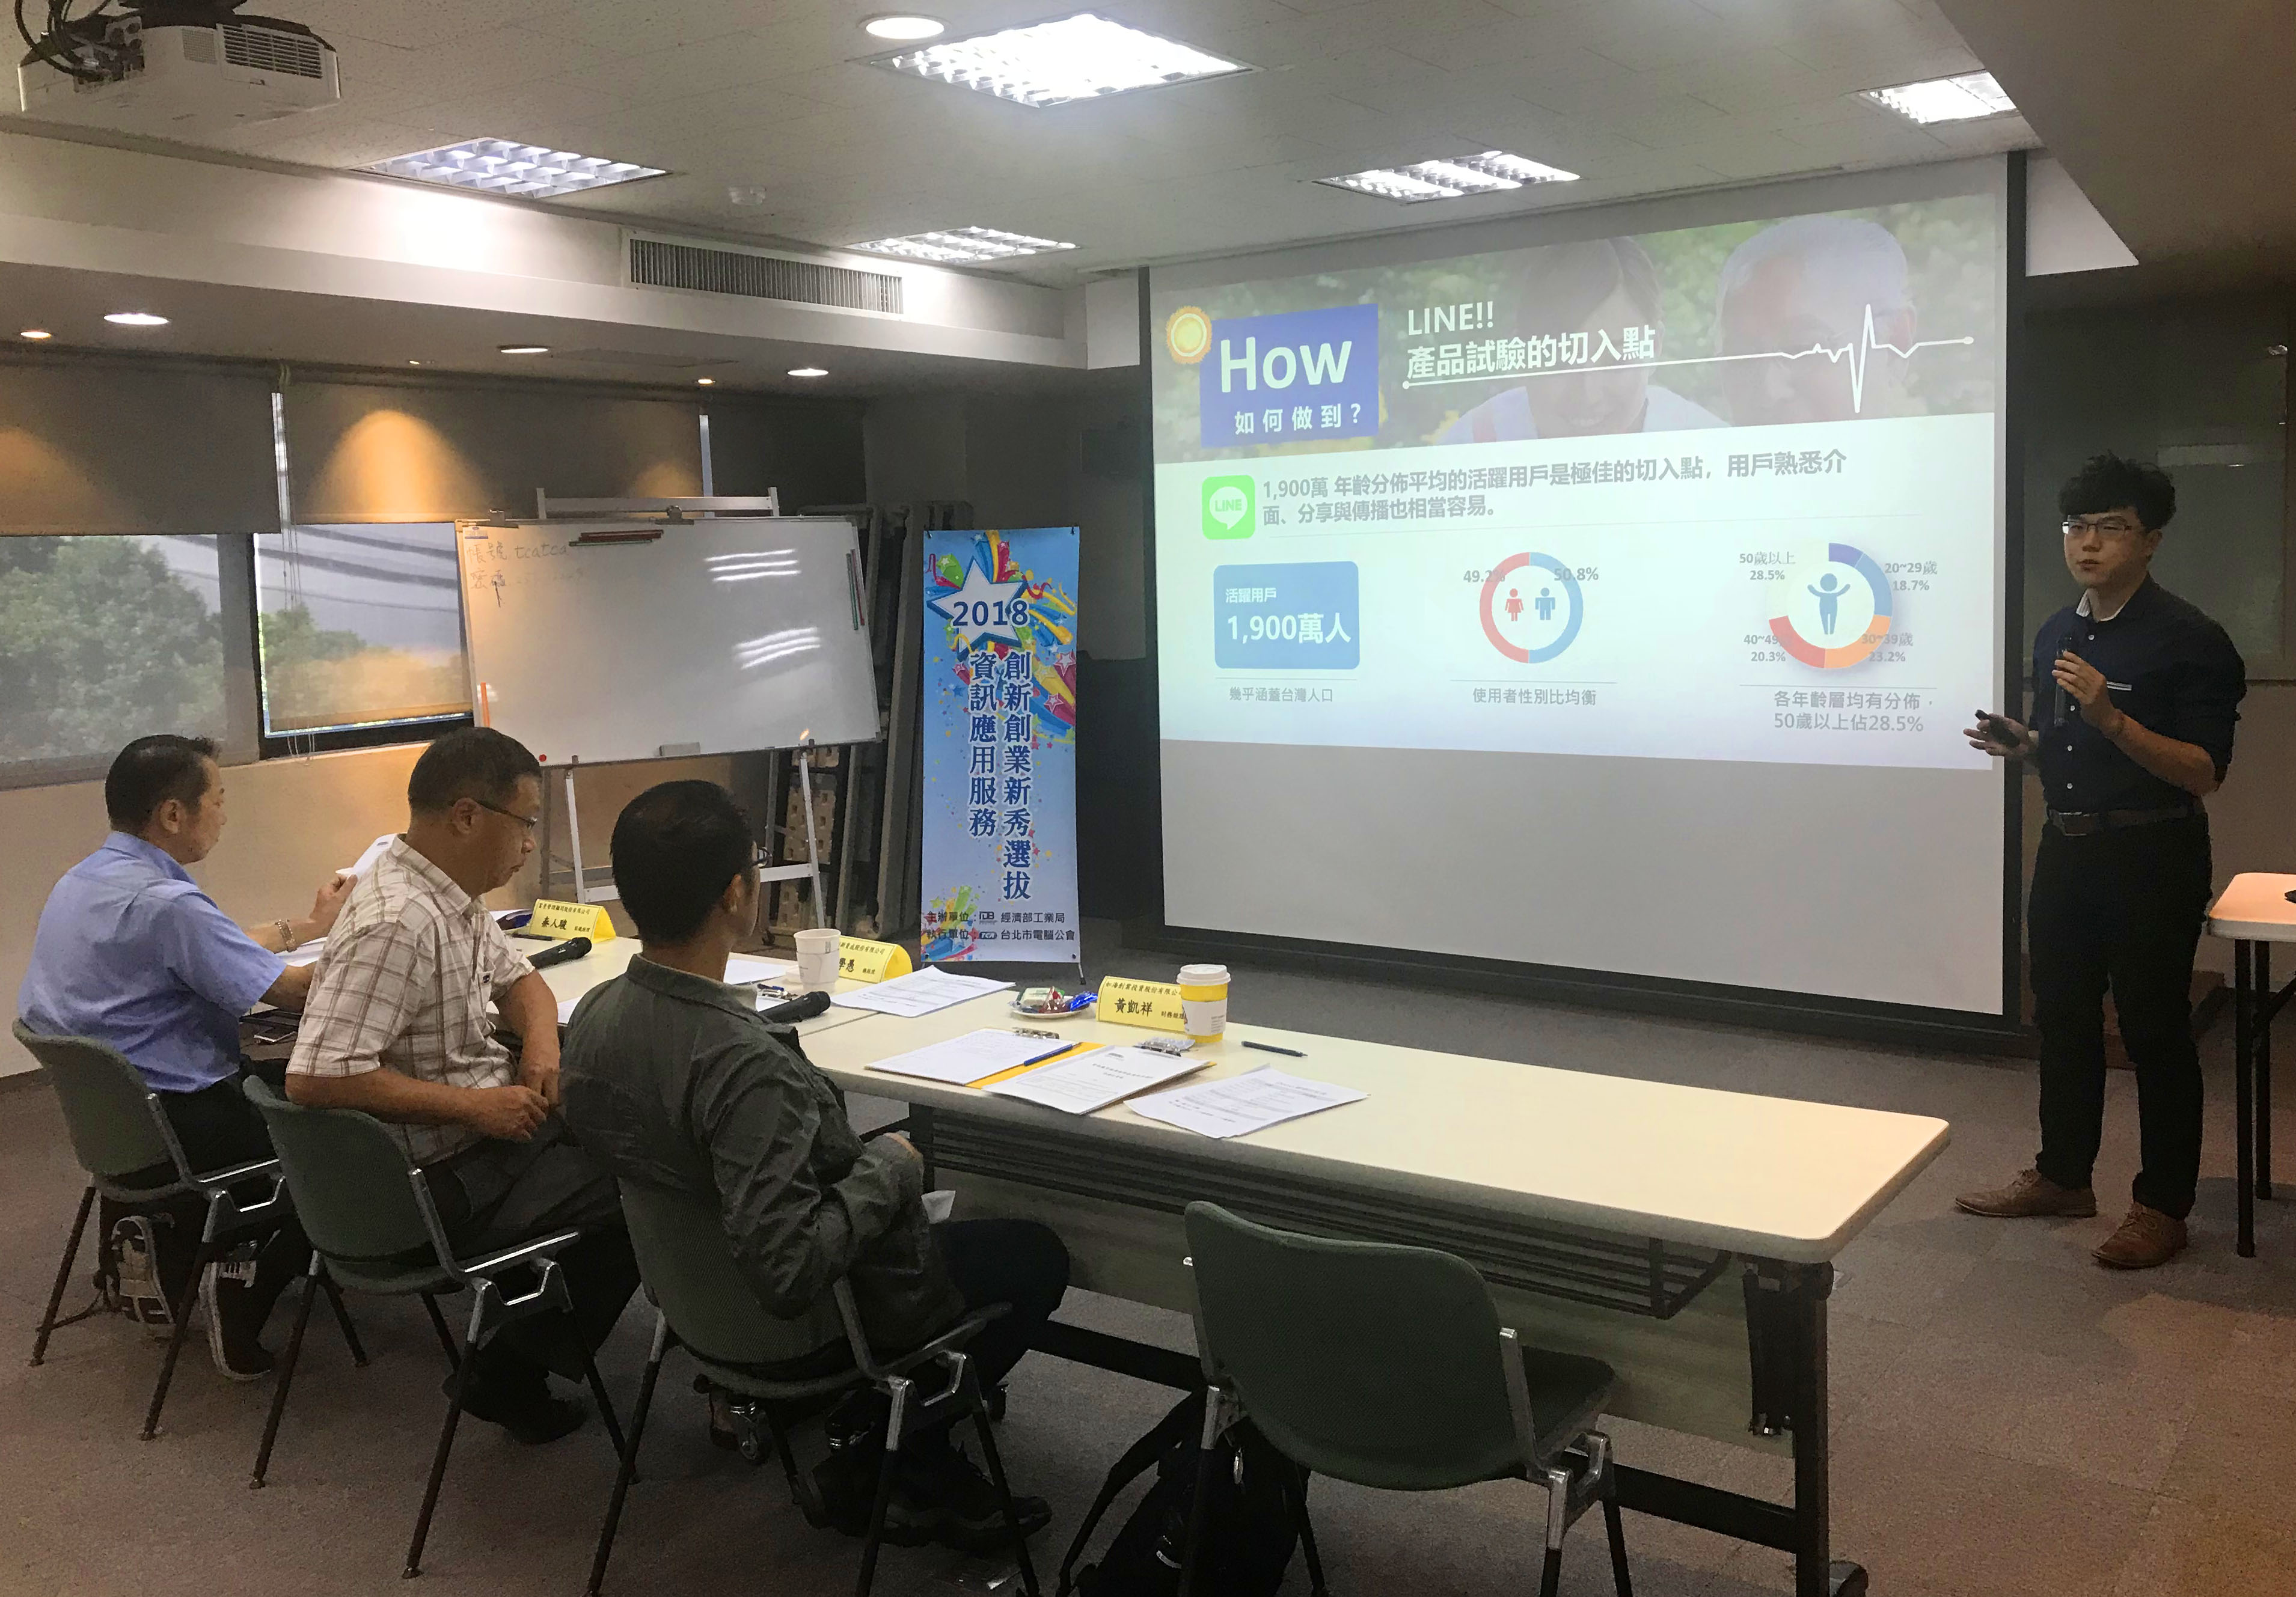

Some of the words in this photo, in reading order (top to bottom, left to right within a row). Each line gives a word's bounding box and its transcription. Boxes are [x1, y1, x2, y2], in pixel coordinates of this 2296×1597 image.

[1408, 301, 1494, 335] LINE!!
[1407, 325, 1655, 379] 產品試驗的切入點
[1220, 337, 1352, 392] How
[1264, 478, 1328, 499] 1,900萬
[1214, 498, 1242, 512] LINE
[1264, 495, 1495, 526] 面、分享與傳播也相當容易。
[1739, 551, 1795, 566] 50歲以上
[1555, 567, 1599, 582] 50.8%
[1750, 569, 1785, 581] 28.5%
[1885, 561, 1937, 575] 20~29歲
[1893, 579, 1929, 591] 18.7%
[1226, 587, 1276, 603] 活躍用戶
[953, 601, 1028, 626] 2018
[1228, 612, 1351, 644] 1,900萬人
[1751, 651, 1786, 662] 20.3%
[1869, 651, 1906, 662] 23.2%
[1229, 687, 1333, 703] 幾乎涵蓋台灣人口
[1473, 688, 1597, 706] 使用者性別比均衡
[1775, 713, 1923, 731] 50歲以上佔28.5%
[969, 653, 997, 836] 資訊應用服務
[1003, 652, 1032, 899] 創新創業新秀選拔
[1001, 912, 1065, 923] 經濟部工業局
[1001, 929, 1075, 940] 台北市電腦公會
[1115, 998, 1153, 1017] 黃凱祥
